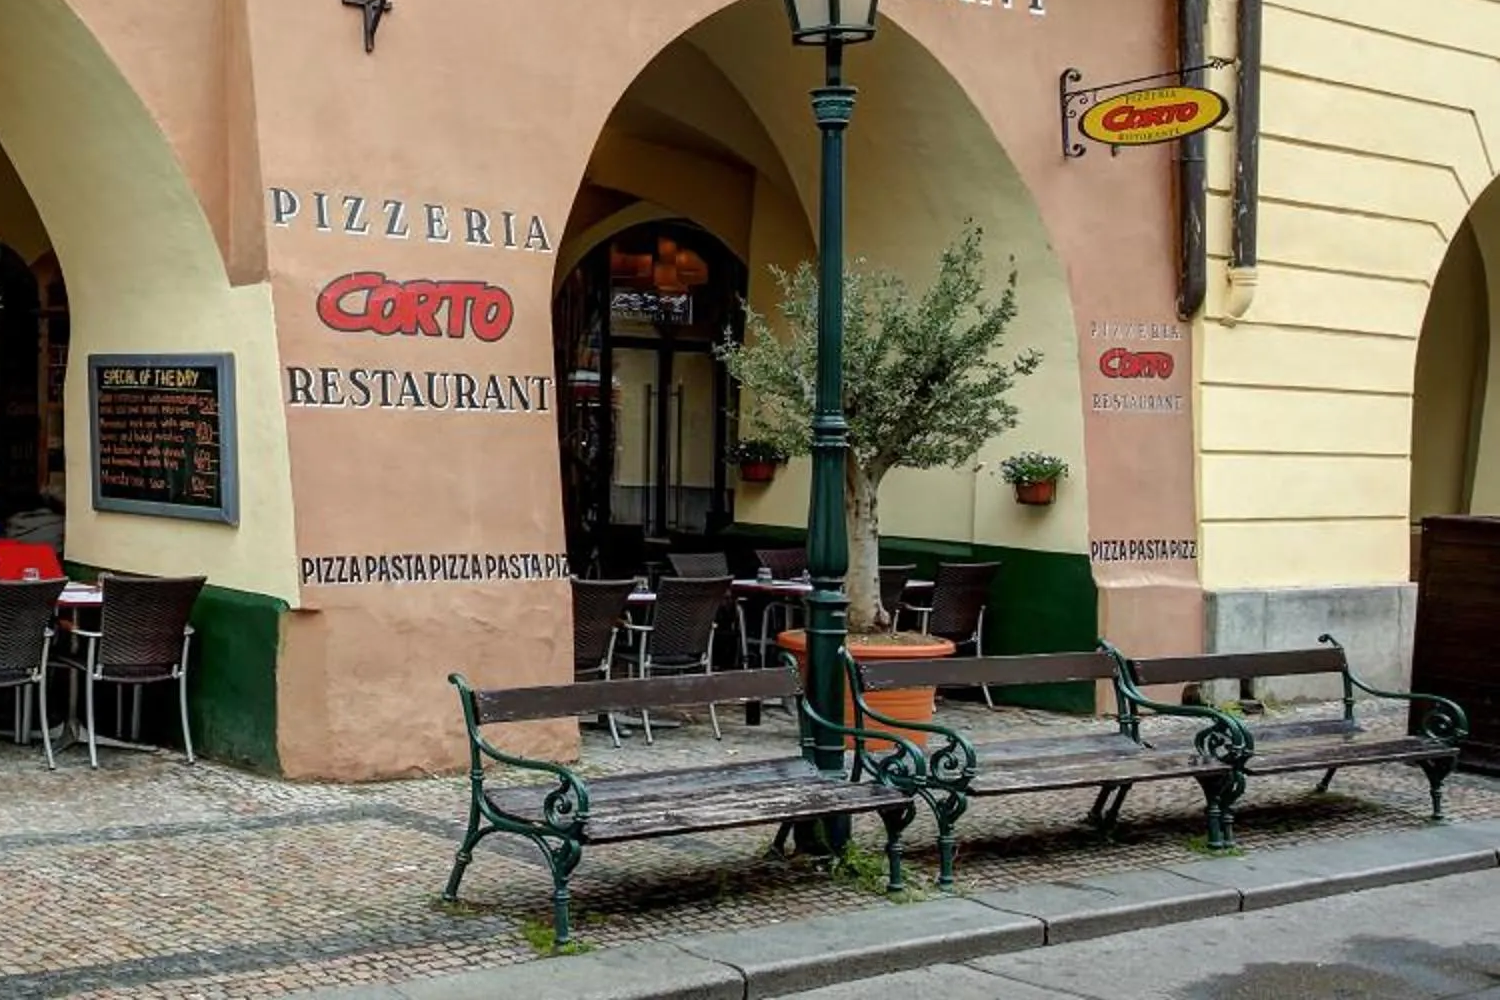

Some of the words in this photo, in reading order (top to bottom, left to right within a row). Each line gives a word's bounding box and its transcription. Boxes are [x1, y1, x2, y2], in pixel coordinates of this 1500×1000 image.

[1102, 101, 1199, 132] CORTO
[270, 187, 553, 253] PIZZERIA
[316, 271, 514, 342] CORTO
[1091, 320, 1184, 340] PIZZERIA
[1099, 347, 1174, 380] CORTO
[286, 366, 553, 412] RESTAURANT
[1092, 393, 1183, 413] RESTAURANT
[1092, 540, 1127, 561] PIZZA
[1129, 539, 1168, 560] PASTA
[301, 555, 363, 585] PIZZA
[366, 554, 428, 583] PASTA
[429, 554, 484, 582] PIZZA
[486, 553, 543, 581] PASTA
